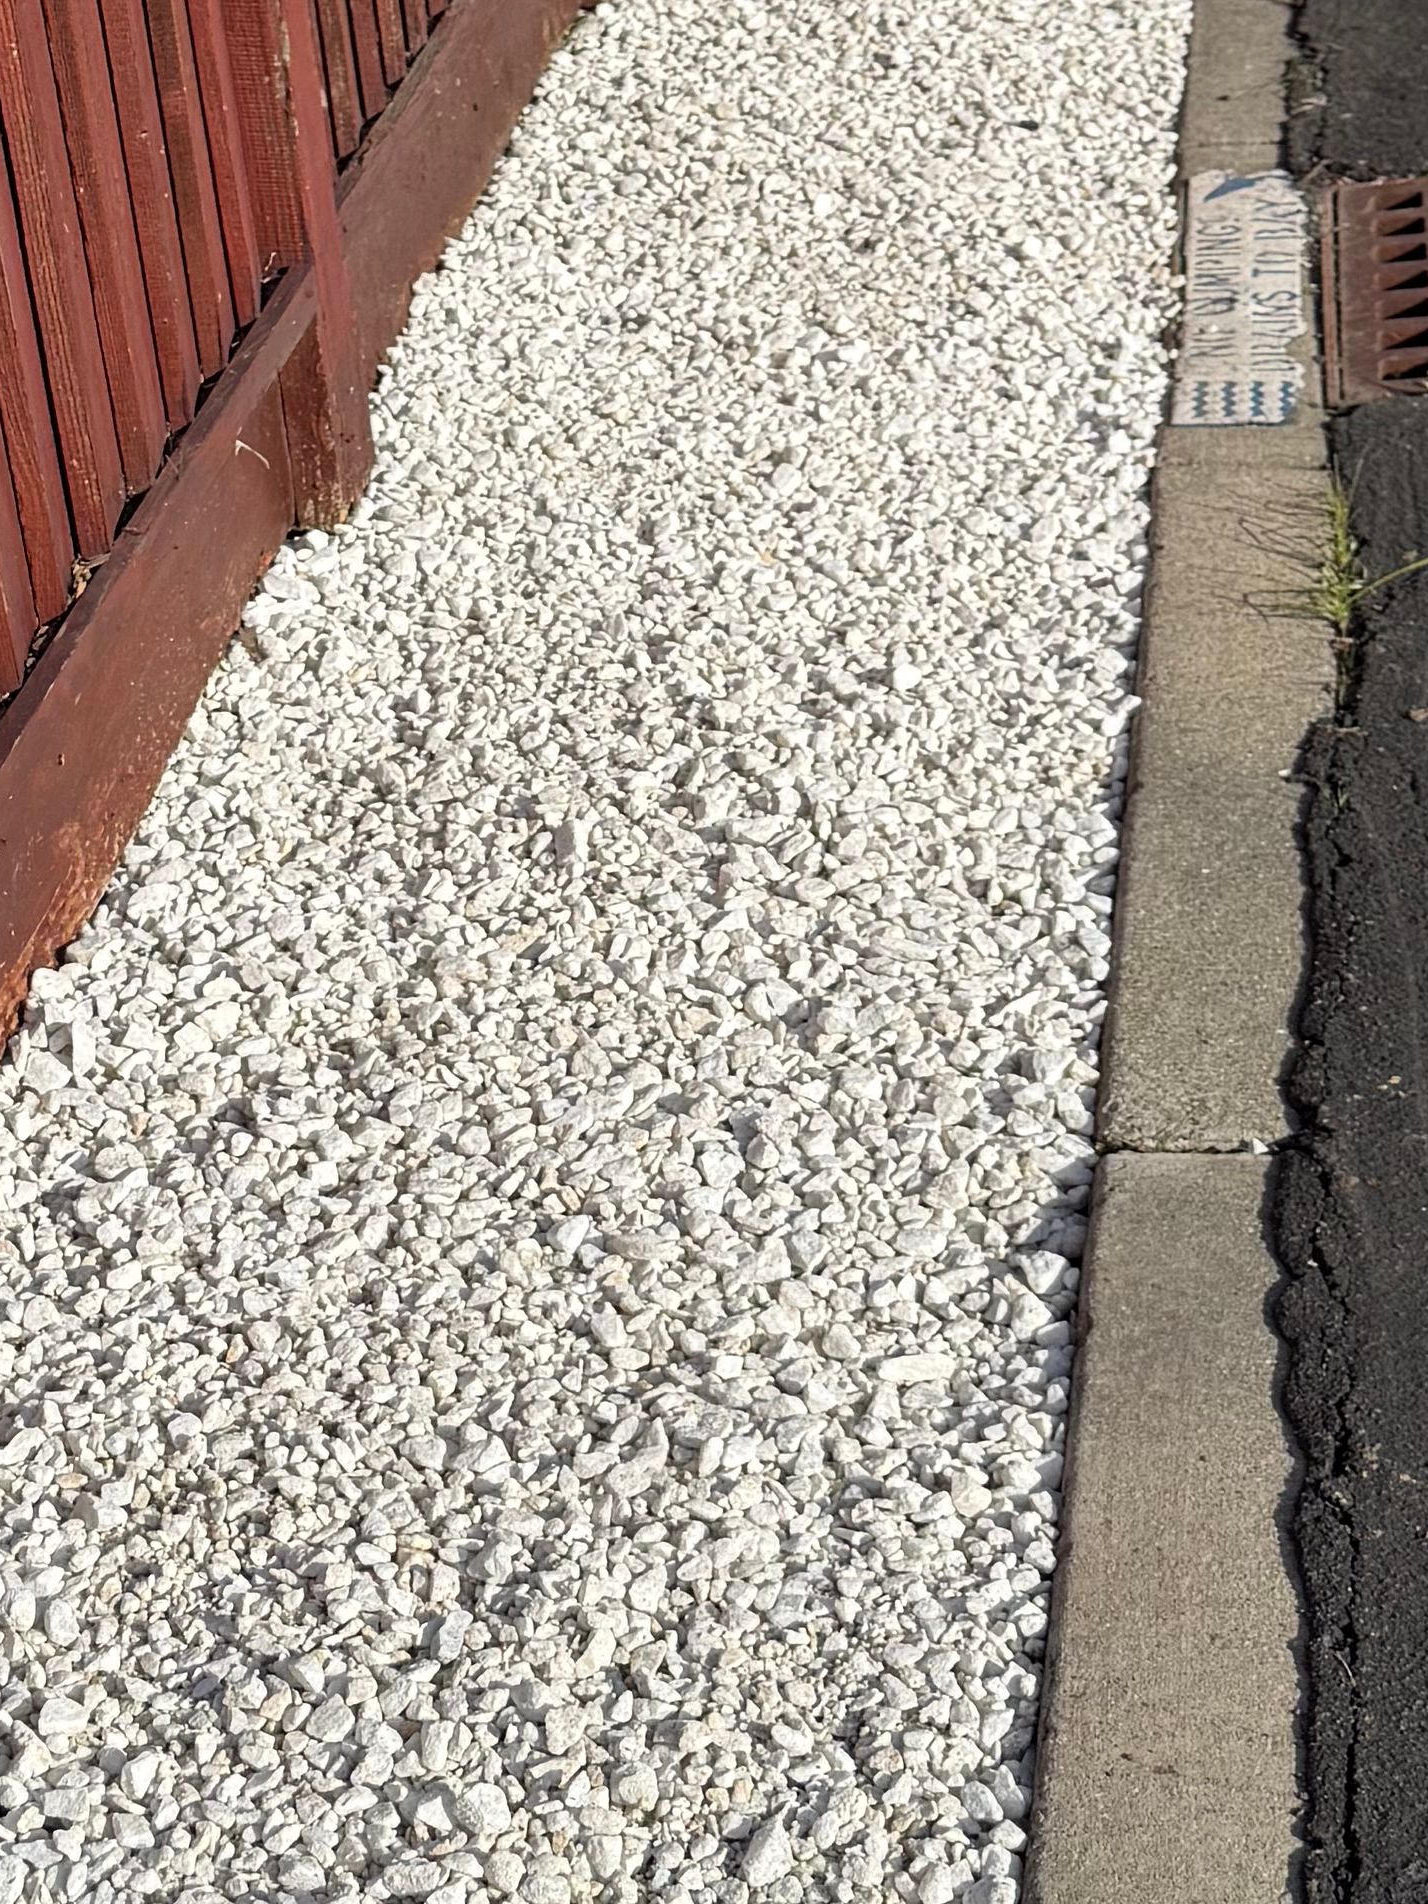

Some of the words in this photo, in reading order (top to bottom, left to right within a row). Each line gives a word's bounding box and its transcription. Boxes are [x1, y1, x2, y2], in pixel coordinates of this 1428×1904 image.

[1251, 198, 1303, 239] BAY
[1252, 251, 1297, 277] TO
[1250, 291, 1297, 372] DRAINS
